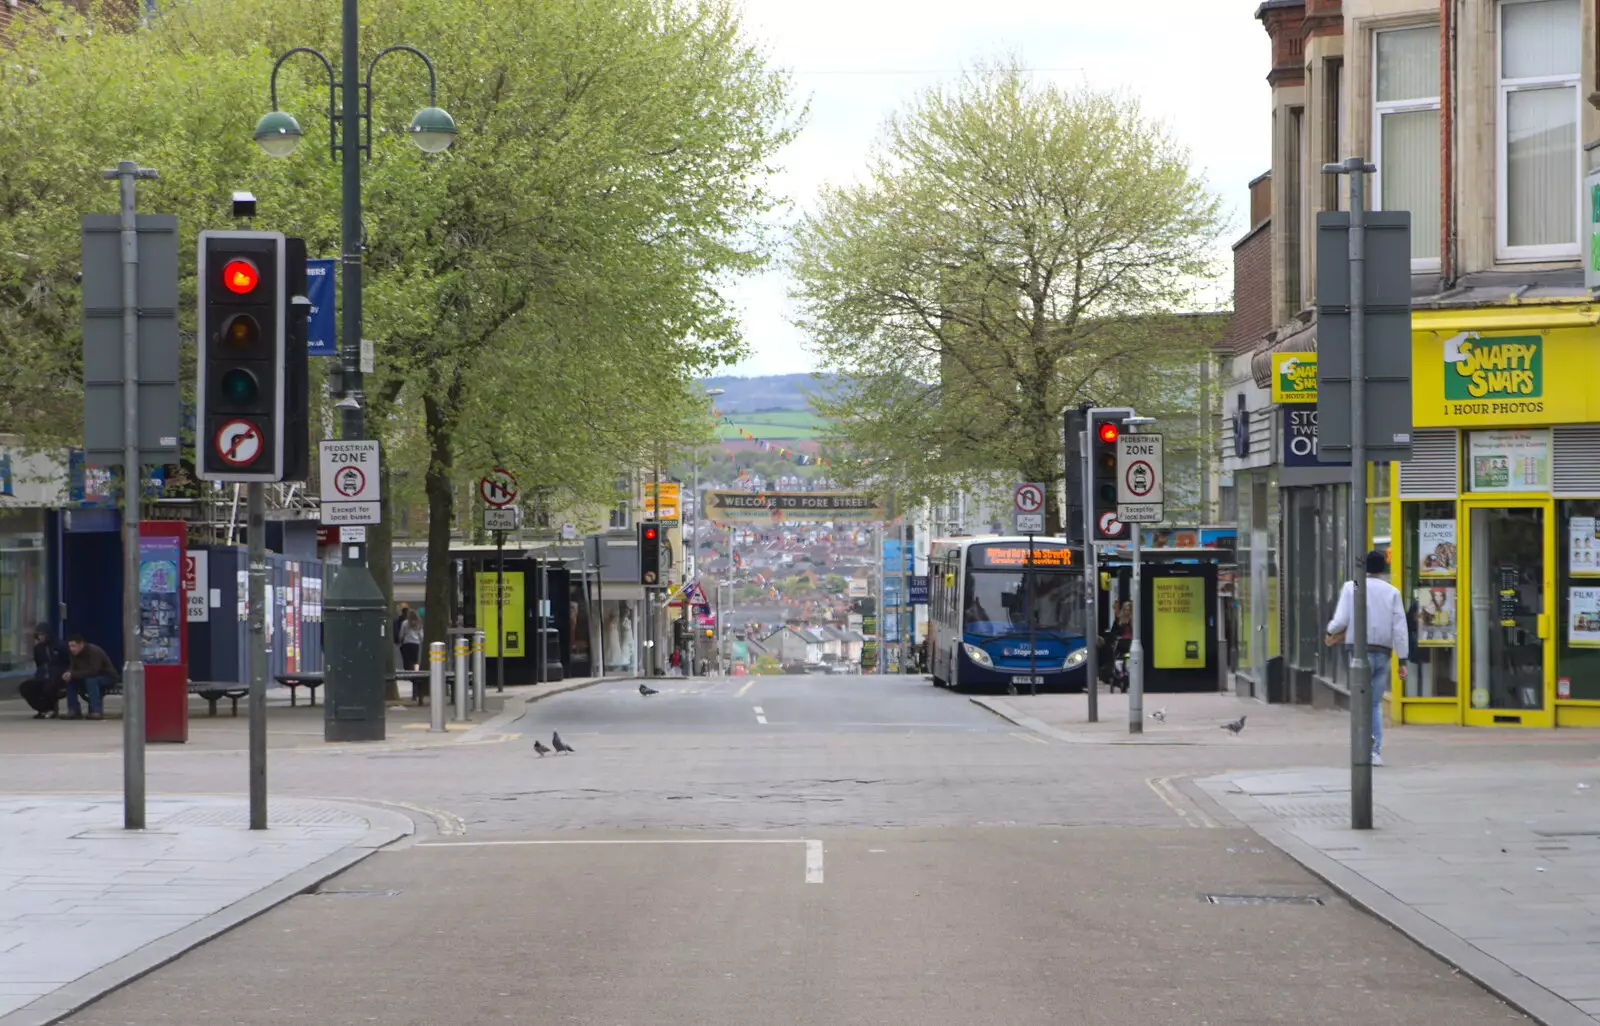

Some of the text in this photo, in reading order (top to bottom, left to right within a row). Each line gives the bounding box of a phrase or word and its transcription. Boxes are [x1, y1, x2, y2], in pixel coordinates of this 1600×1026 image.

[1456, 342, 1537, 377] SNAPPY
[1467, 369, 1534, 397] SNAPS
[1443, 402, 1544, 415] 1 HOUR PHOTOS
[1120, 435, 1160, 443] PEDESTRIAN
[324, 444, 375, 452] PEDESTRIAN
[1126, 445, 1154, 455] ZONE
[331, 453, 368, 463] ZONE
[783, 498, 797, 507] TO
[802, 498, 829, 508] FORE
[833, 498, 868, 507] STREET
[1573, 591, 1594, 599] FILM
